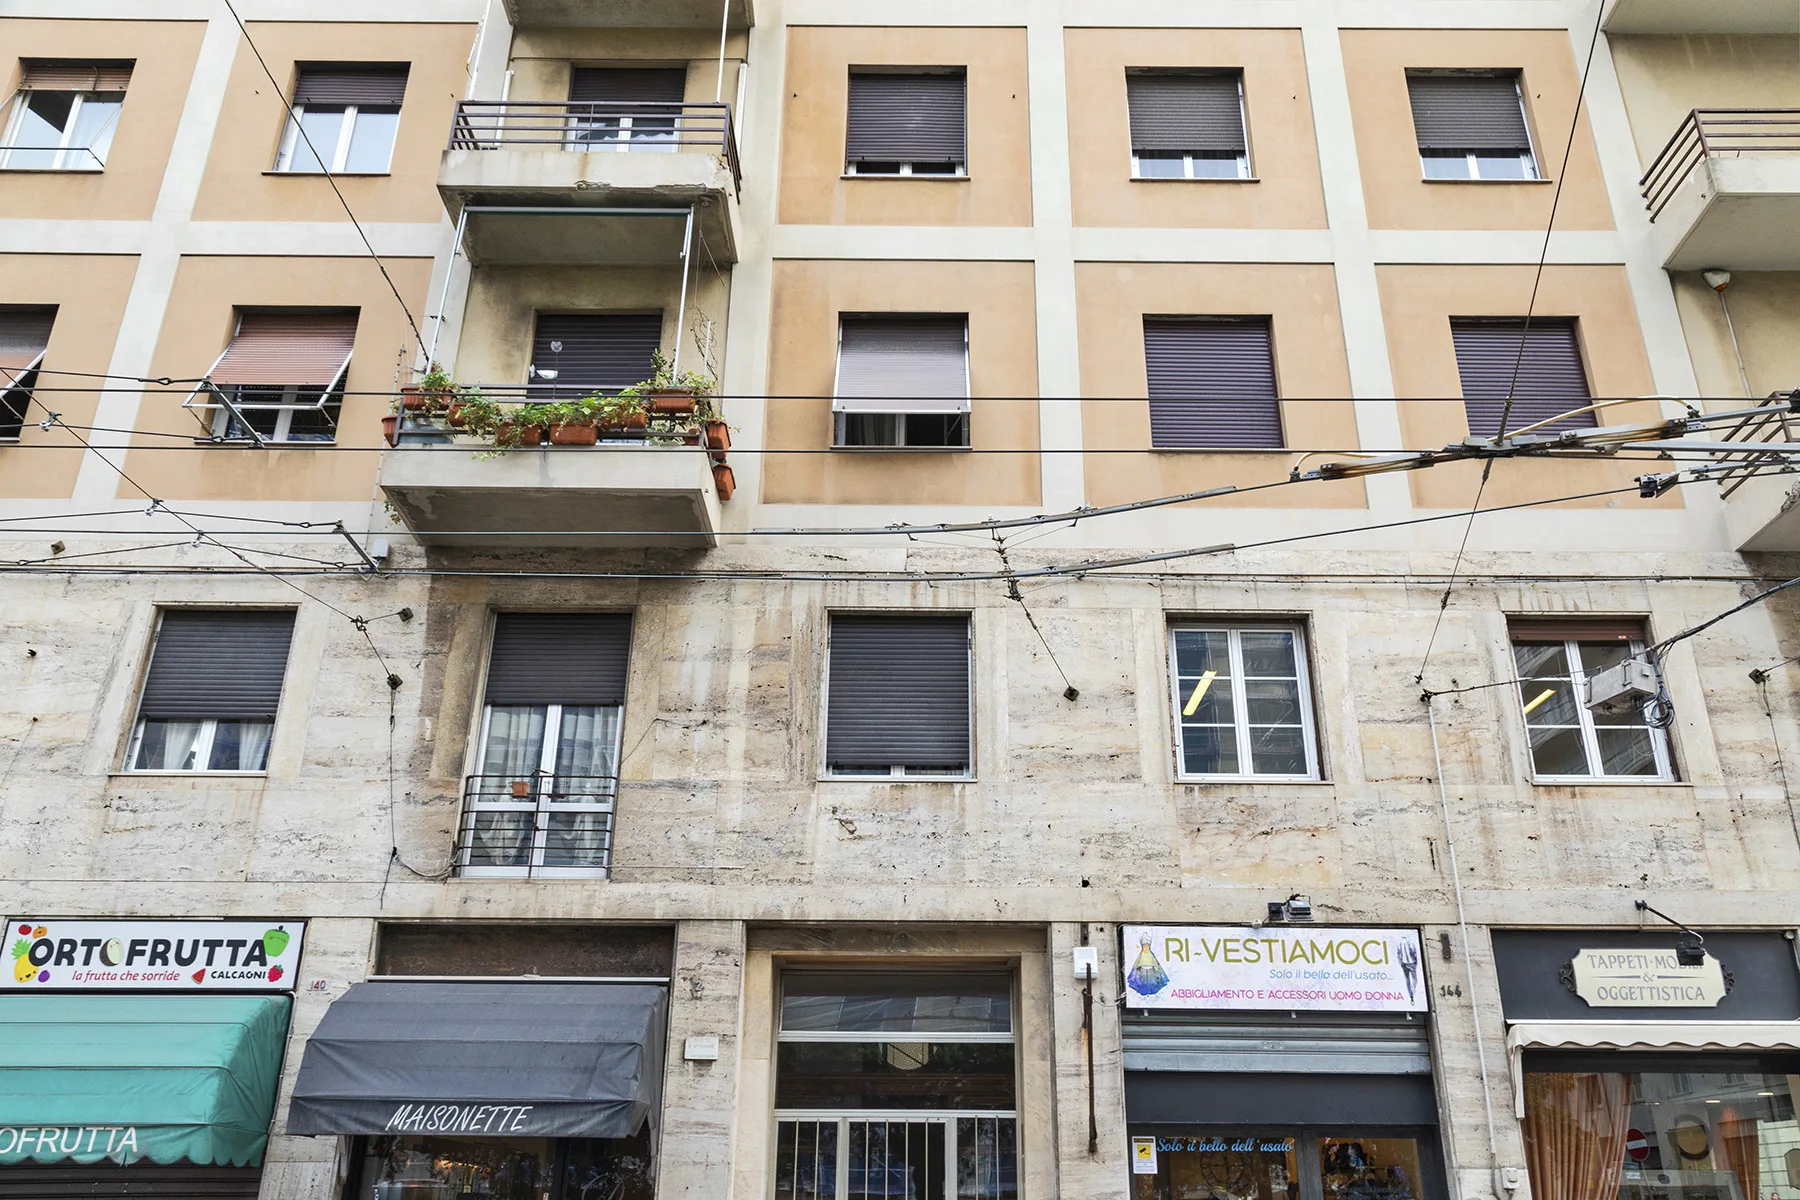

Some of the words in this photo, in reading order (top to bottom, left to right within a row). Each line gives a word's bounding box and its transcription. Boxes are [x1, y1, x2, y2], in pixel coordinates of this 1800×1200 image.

[71, 970, 82, 981] la
[84, 970, 117, 983] frutta
[119, 971, 139, 981] che
[141, 971, 180, 981] sorride
[210, 970, 266, 979] CALCAGNI
[1269, 969, 1293, 979] Solo
[1295, 970, 1300, 979] il
[1303, 970, 1331, 980] bello
[1643, 971, 1656, 982] &
[310, 980, 326, 990] 140
[1170, 989, 1255, 999] ABBIGLIAMENTO
[1257, 990, 1264, 999] E
[1267, 990, 1327, 1000] ACCESSORI
[1329, 990, 1363, 1001] UOMO
[1365, 991, 1405, 1001] DONNA
[1597, 986, 1705, 1001] OGGETTISTICA
[385, 1104, 533, 1131] MAISONETTE
[1157, 1137, 1184, 1152] Solo
[1187, 1139, 1196, 1152] il
[1199, 1137, 1228, 1152] bello
